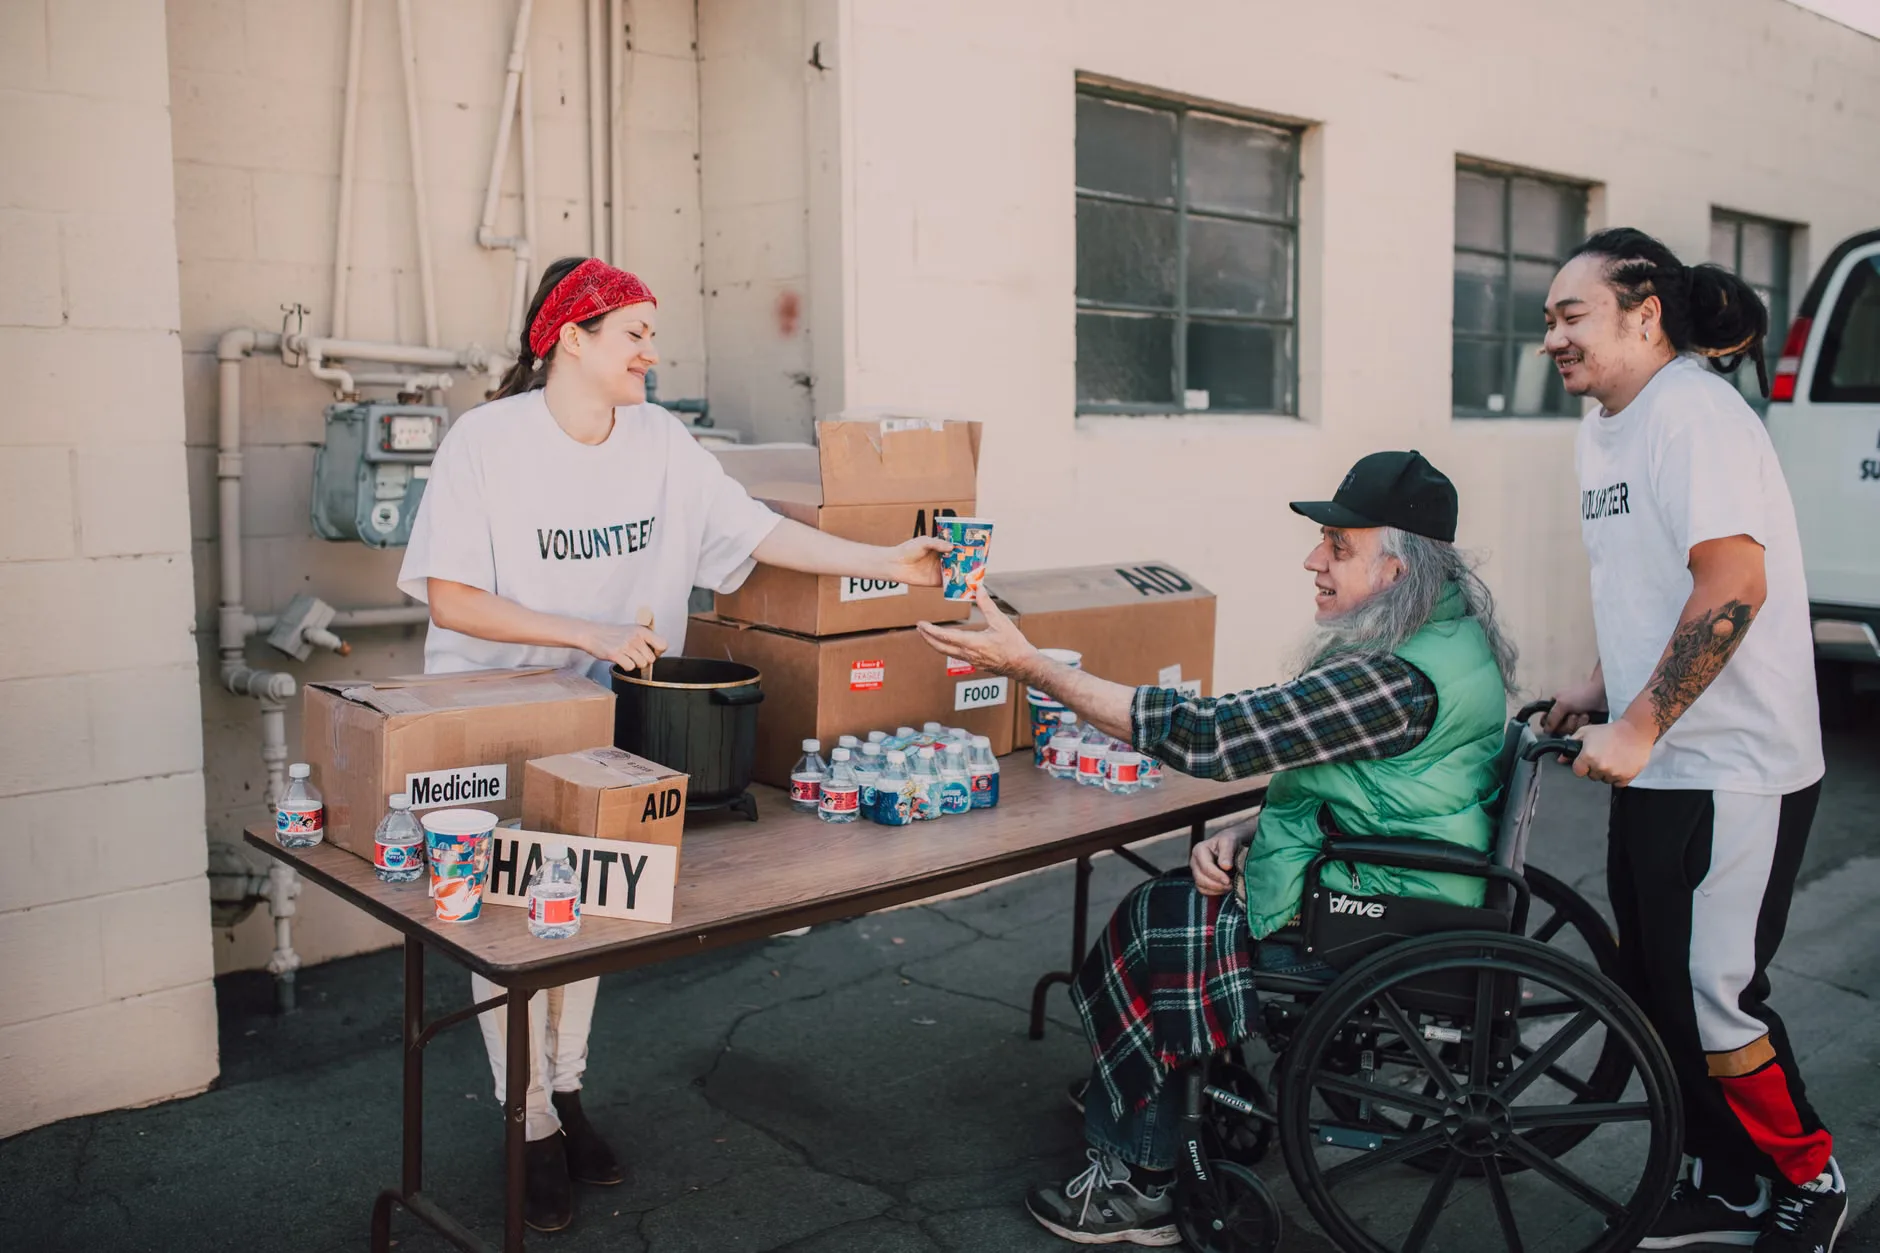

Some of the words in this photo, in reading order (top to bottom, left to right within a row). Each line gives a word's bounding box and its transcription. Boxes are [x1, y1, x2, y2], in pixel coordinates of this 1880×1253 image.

[913, 509, 957, 538] AI
[1115, 566, 1193, 596] AID
[963, 685, 1000, 702] FOOD
[411, 772, 500, 805] Medicine
[640, 788, 682, 823] AID
[486, 838, 648, 910] HAITY
